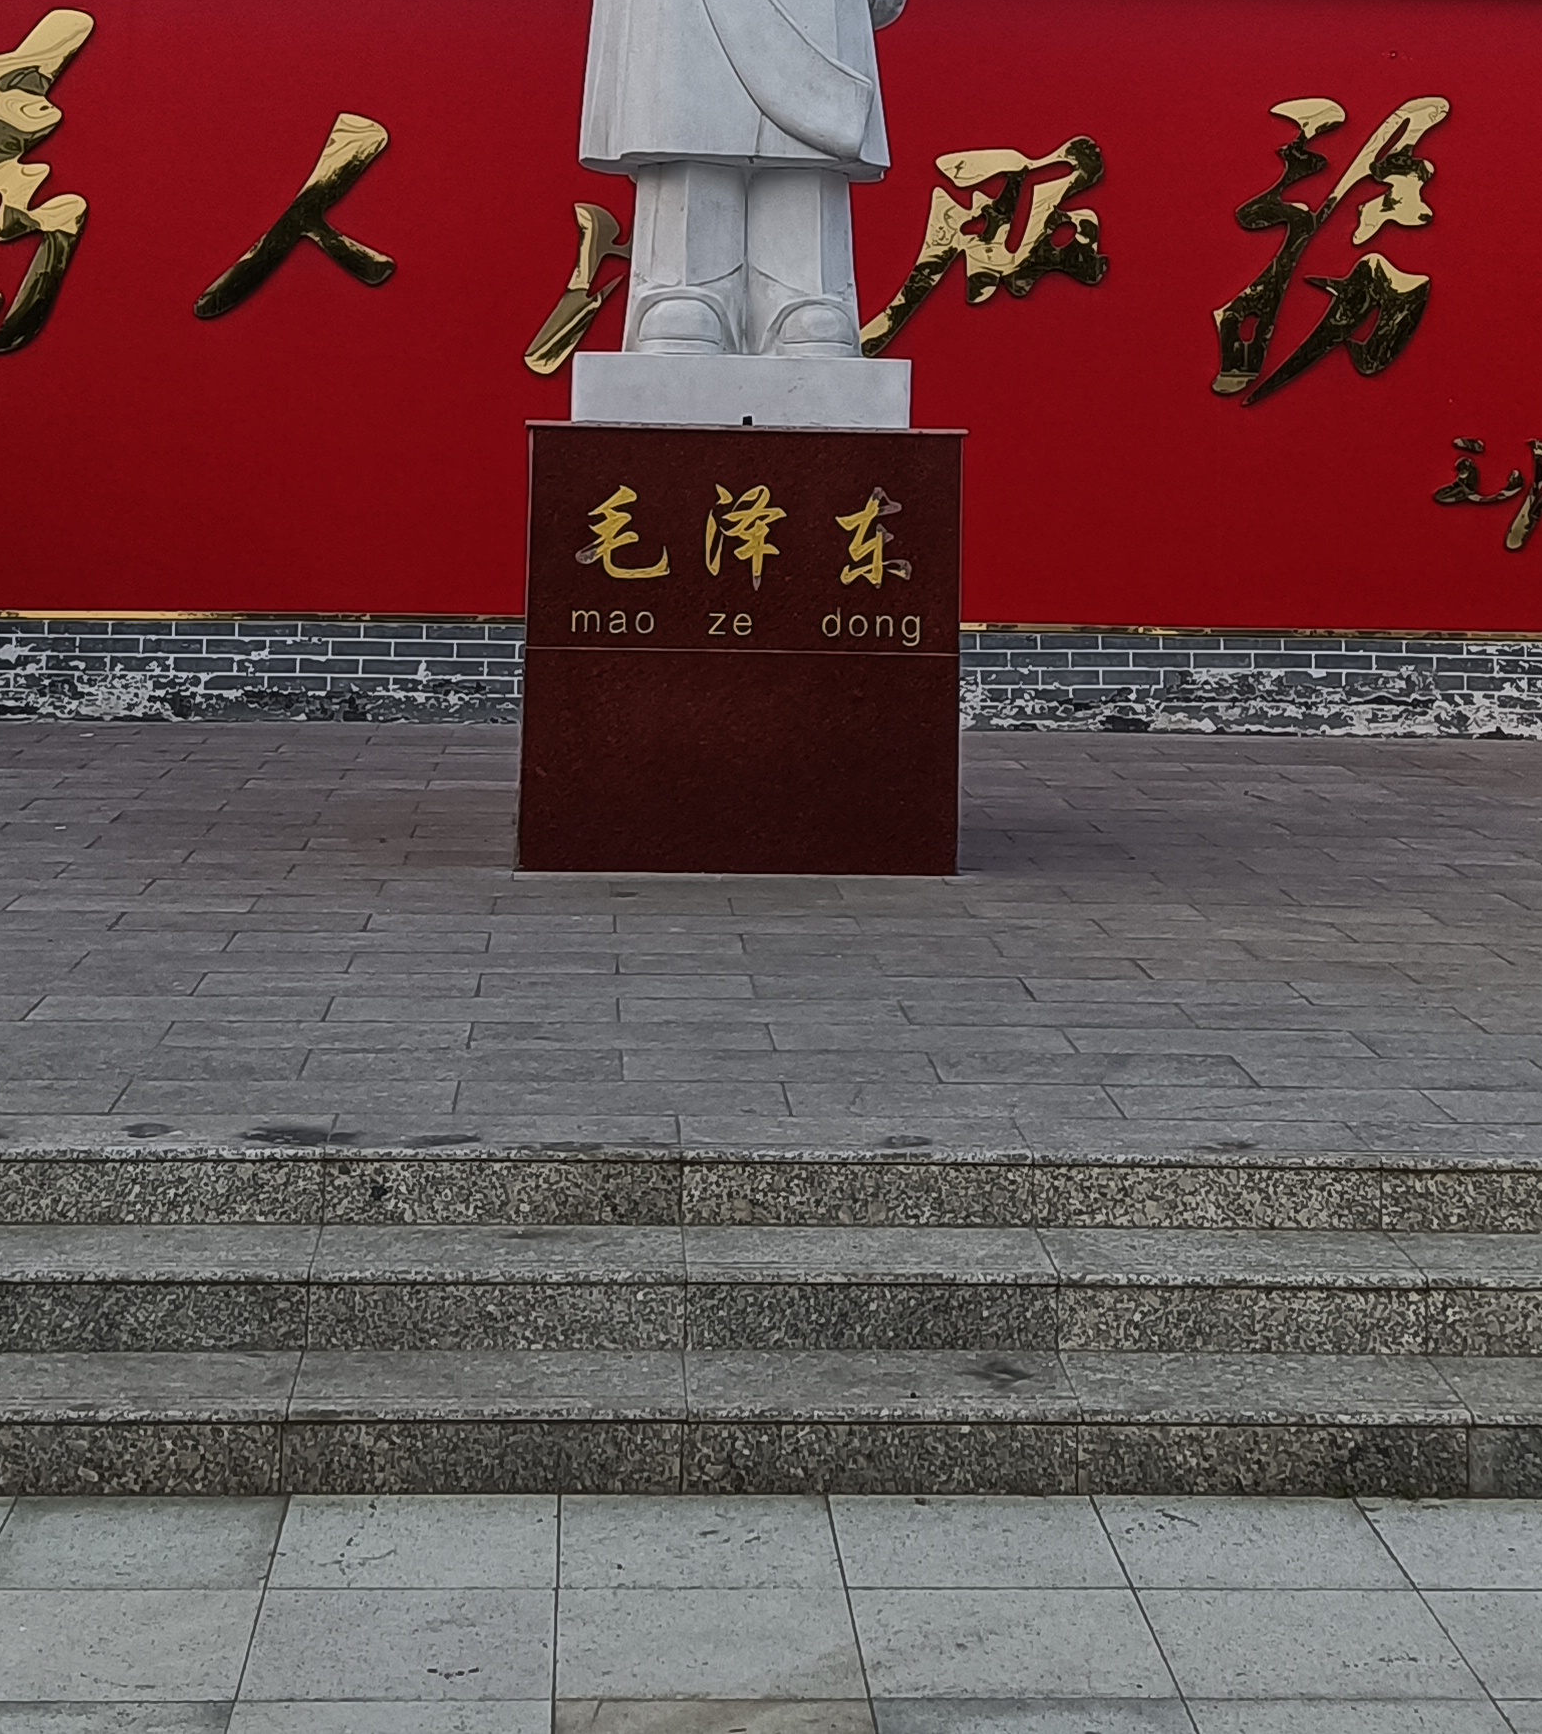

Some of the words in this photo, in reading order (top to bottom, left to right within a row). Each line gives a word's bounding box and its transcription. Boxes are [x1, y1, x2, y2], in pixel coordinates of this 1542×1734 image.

[574, 483, 913, 591] 毛泽东
[569, 606, 656, 635] mao
[708, 611, 753, 637] ze
[821, 607, 923, 647] dong
